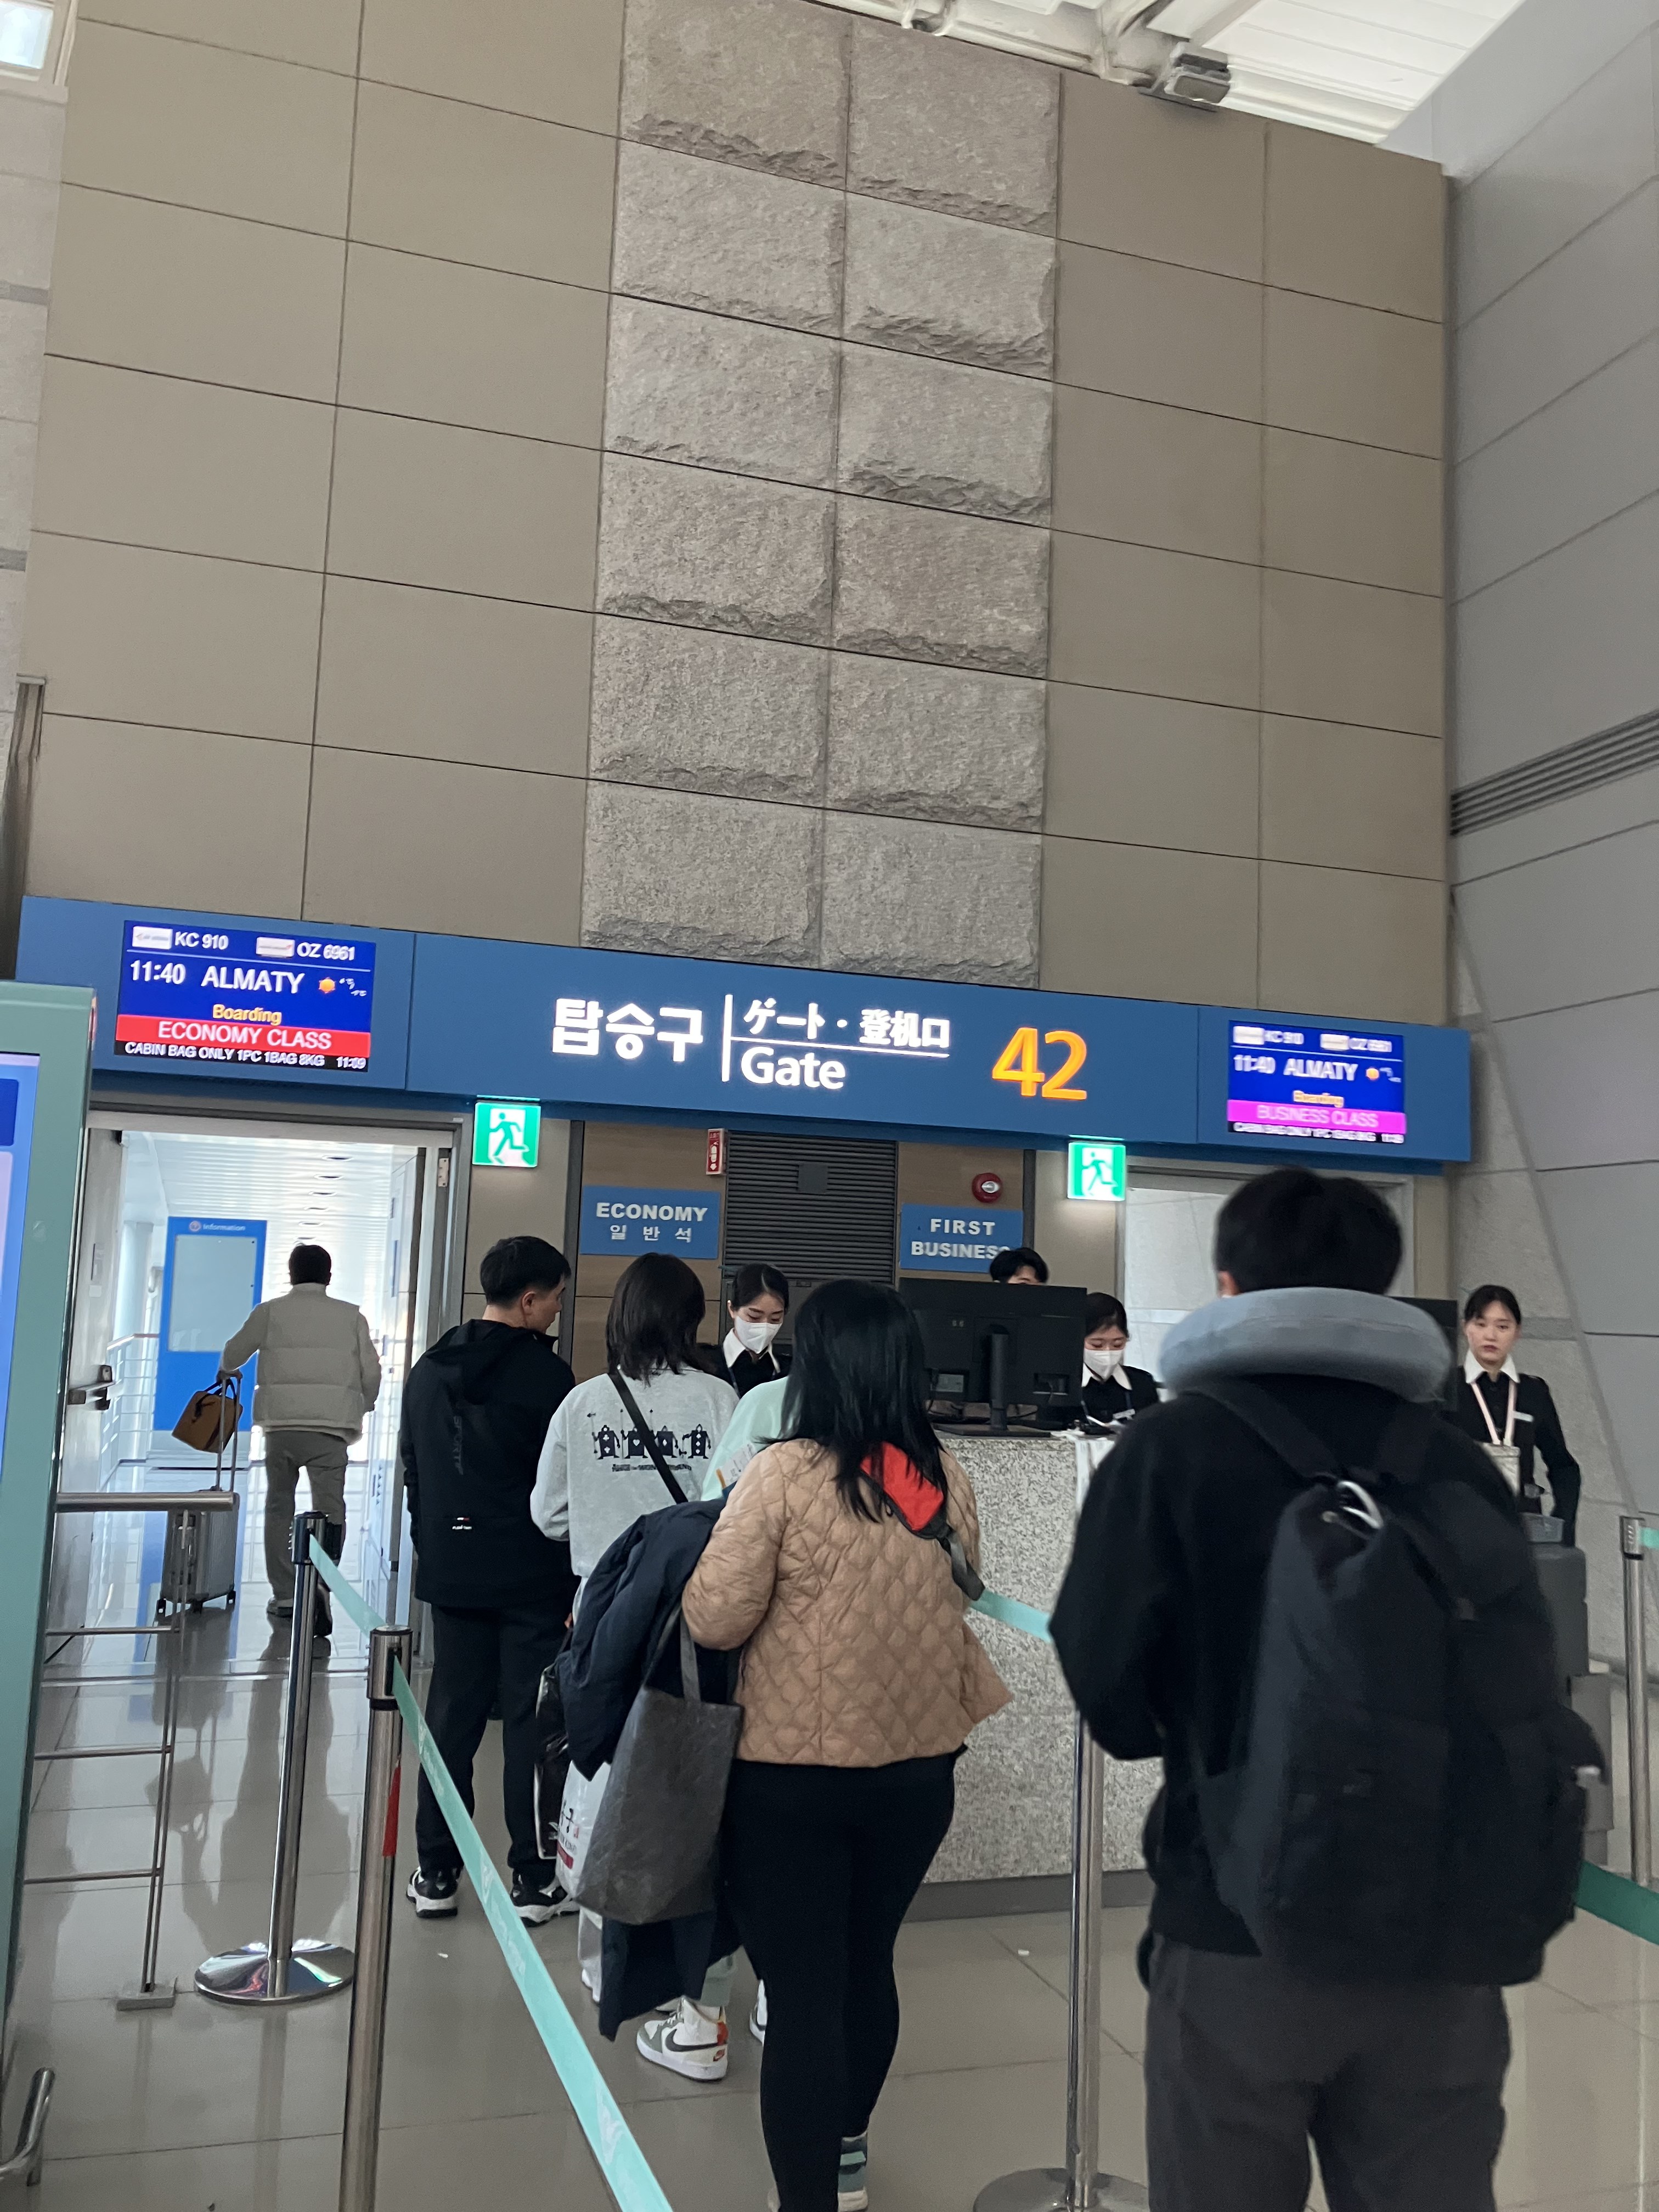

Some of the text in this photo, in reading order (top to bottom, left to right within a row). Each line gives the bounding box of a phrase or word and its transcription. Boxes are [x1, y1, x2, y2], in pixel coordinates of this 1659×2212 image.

[175, 931, 229, 950] KC 910
[297, 942, 322, 958] OZ
[131, 960, 305, 994] 11:40 ALMATY
[212, 1004, 282, 1025] Boarding
[158, 1021, 332, 1049] ECONOMY CLASS
[552, 998, 703, 1062] 탑승구
[125, 1042, 166, 1056] CABIN
[168, 1045, 196, 1058] BAG
[198, 1047, 235, 1060] ONLY
[237, 1049, 262, 1062] 1PC
[264, 1051, 298, 1065] 1BAG
[298, 1053, 325, 1066] 8KG
[992, 1027, 1087, 1101] 42
[741, 1046, 846, 1090] Gate
[1283, 1058, 1358, 1081] ALMATY
[1256, 1104, 1379, 1128] BUSINESS CLASS
[596, 1203, 708, 1221] ECONOMY
[930, 1218, 995, 1235] FIRST
